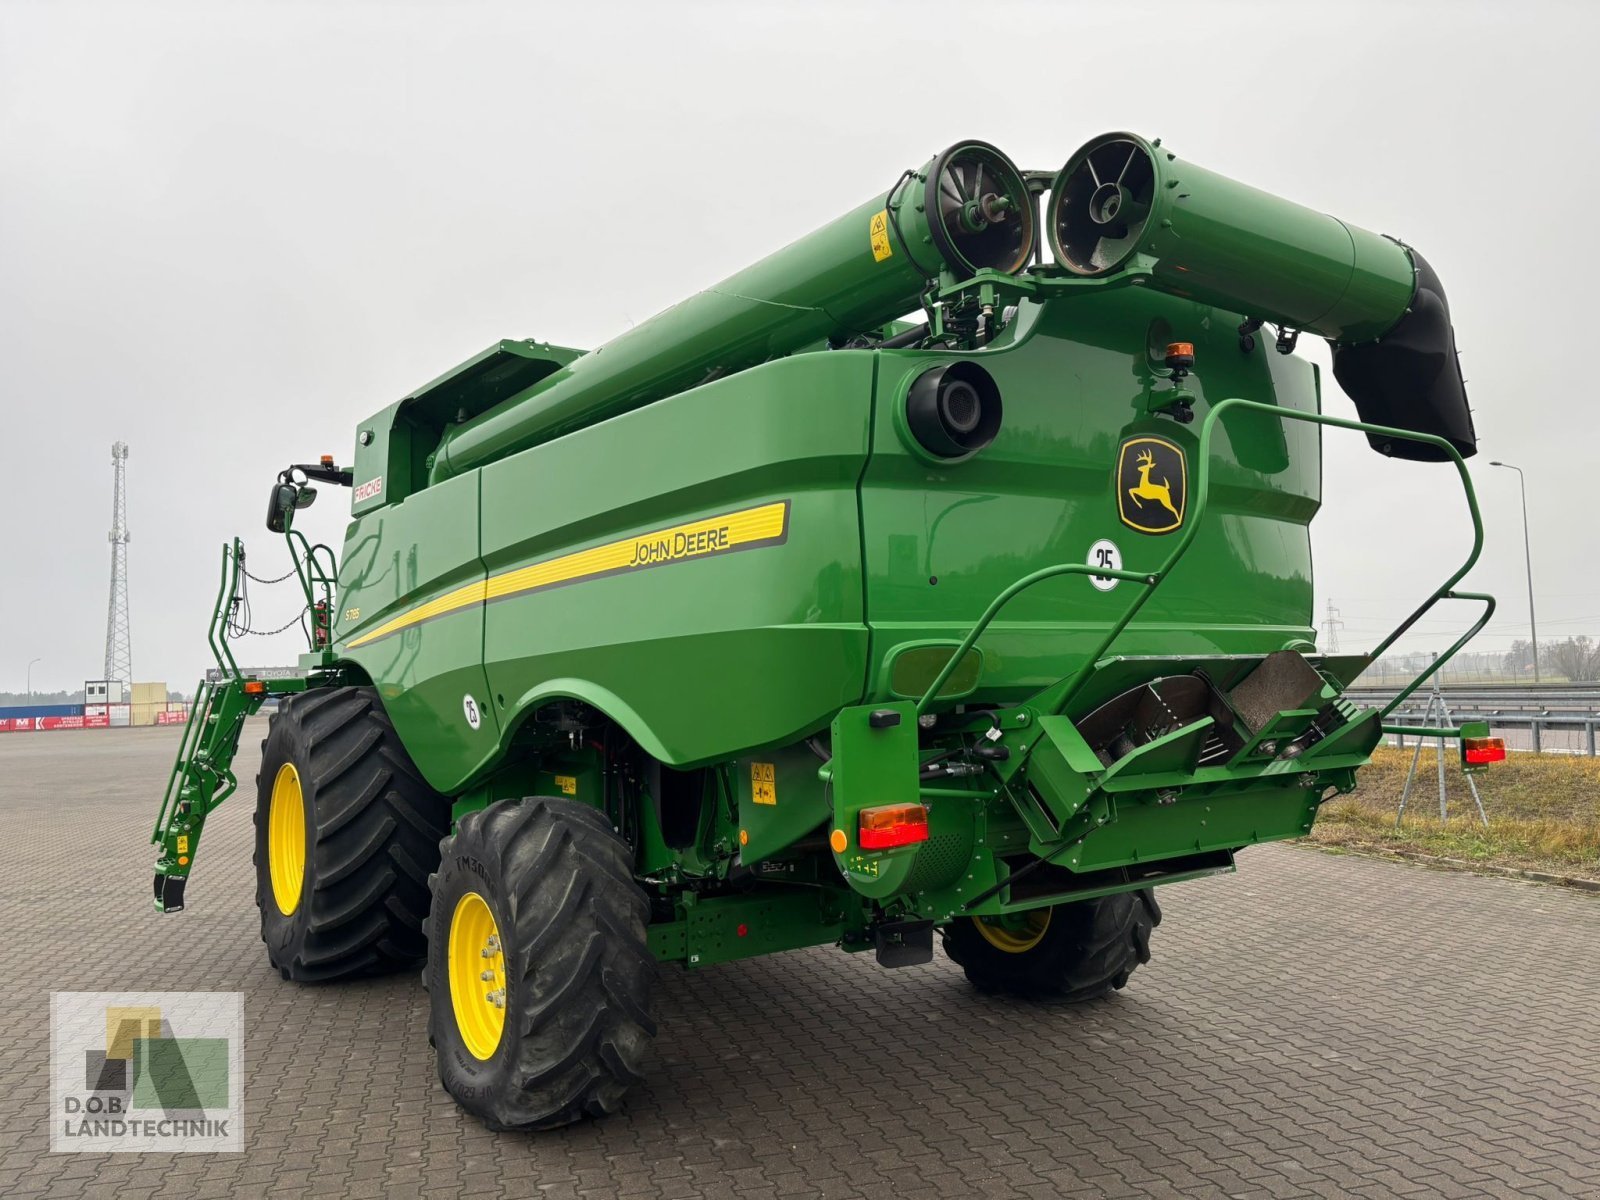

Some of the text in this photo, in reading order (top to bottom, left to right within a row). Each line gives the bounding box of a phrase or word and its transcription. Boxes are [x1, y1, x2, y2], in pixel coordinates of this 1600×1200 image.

[355, 478, 382, 500] FRICKE
[630, 526, 729, 565] JOHN DEERE
[1096, 548, 1114, 581] 25
